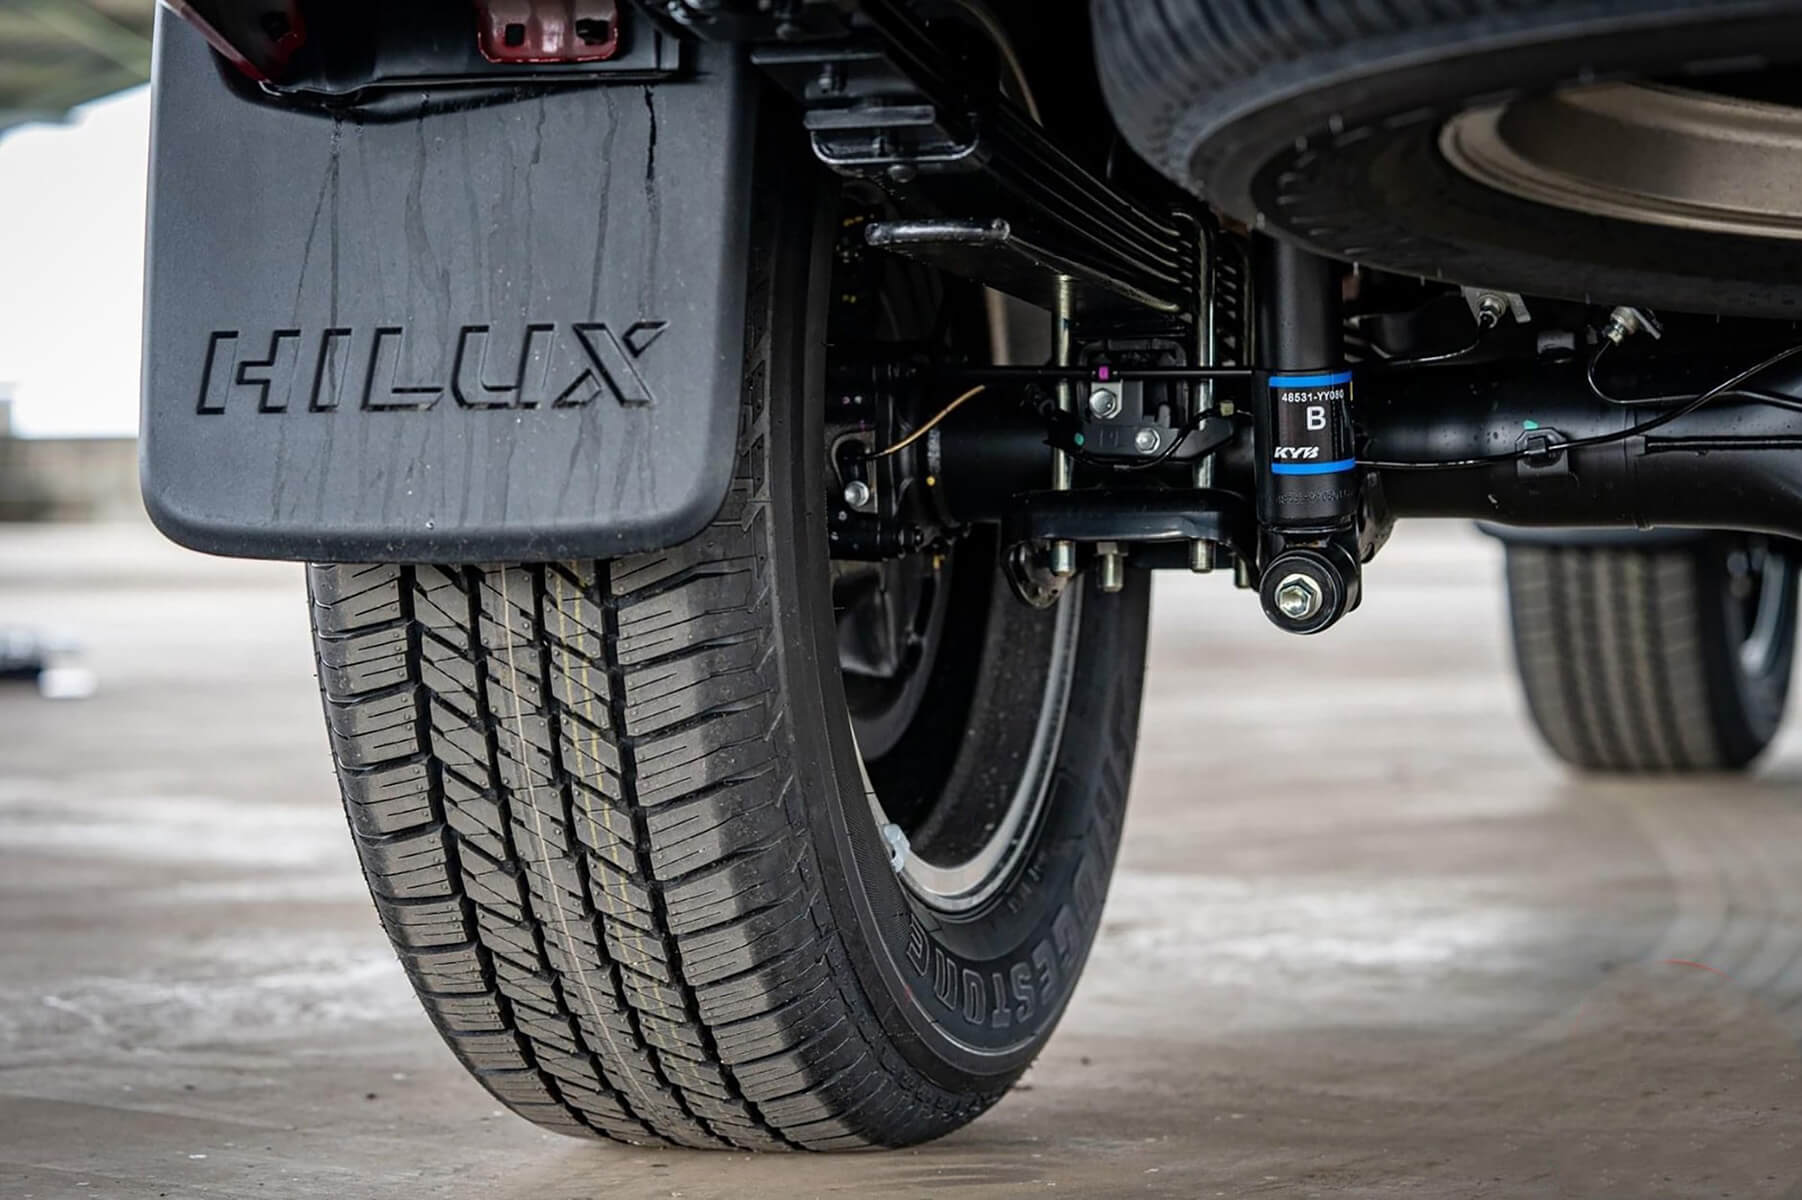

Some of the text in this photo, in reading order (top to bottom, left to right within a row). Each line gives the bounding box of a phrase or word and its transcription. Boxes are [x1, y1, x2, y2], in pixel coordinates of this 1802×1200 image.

[196, 321, 668, 415] HILUX
[1307, 406, 1327, 430] B
[1274, 446, 1320, 459] KYB
